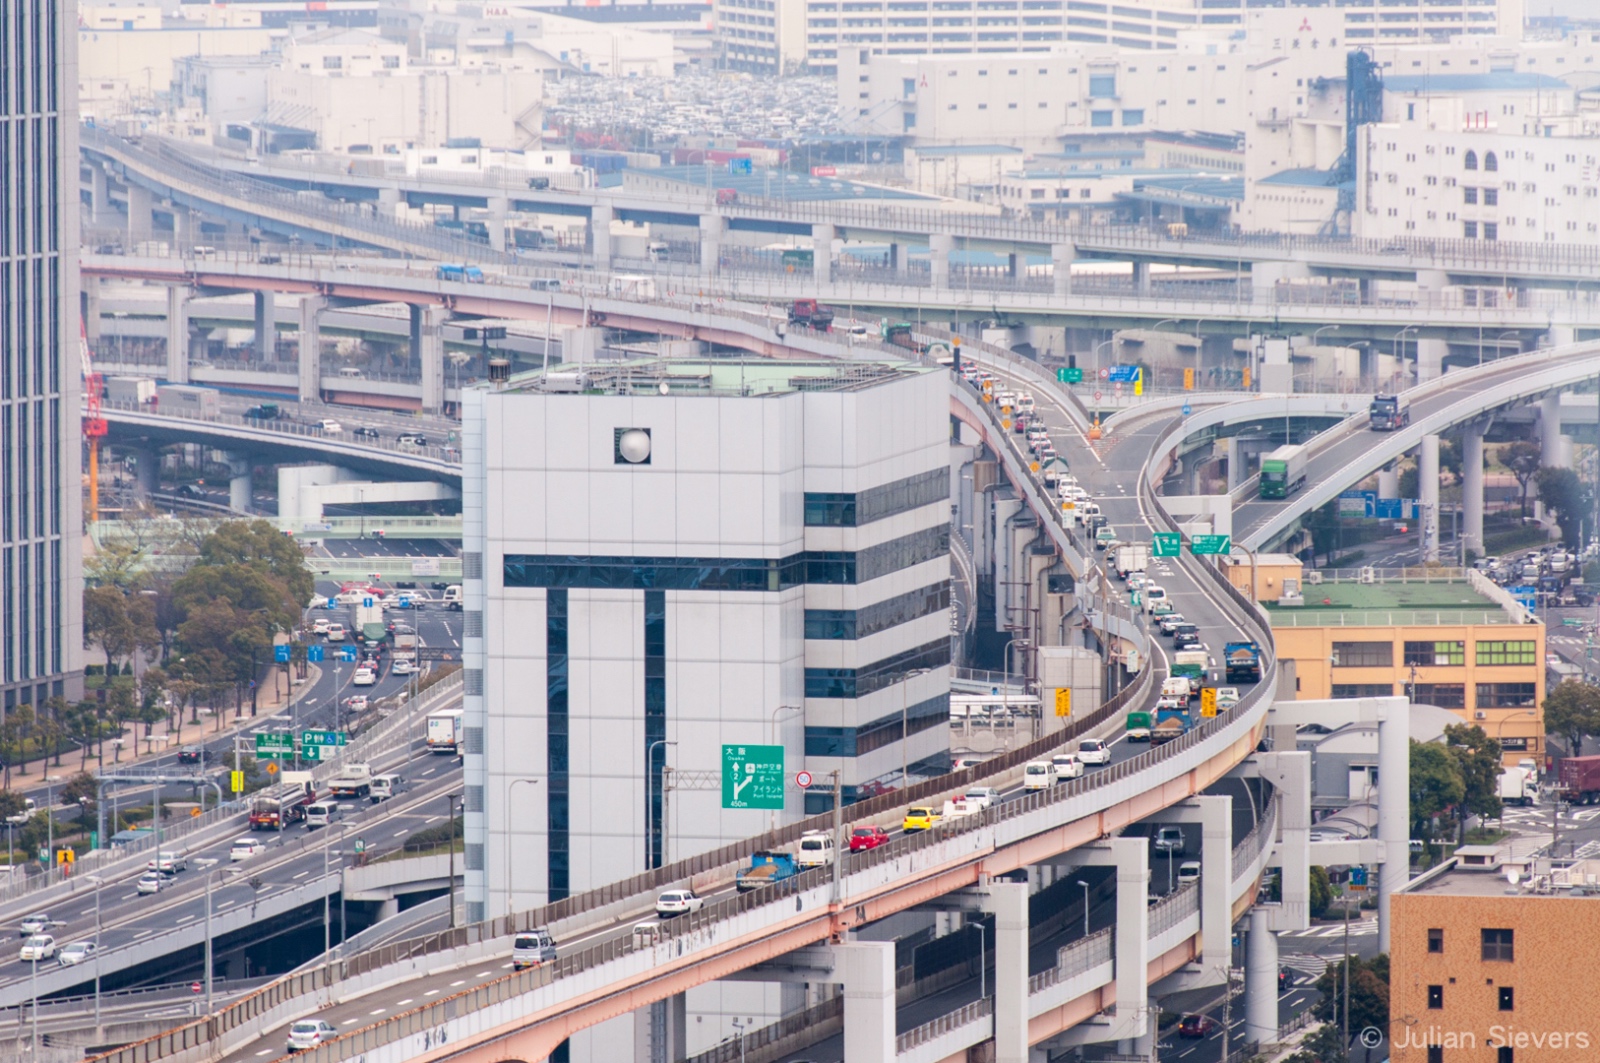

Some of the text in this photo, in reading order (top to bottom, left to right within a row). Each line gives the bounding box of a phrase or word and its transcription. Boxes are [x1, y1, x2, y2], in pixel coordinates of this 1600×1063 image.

[486, 7, 508, 16] HAA
[304, 733, 312, 743] P
[726, 747, 746, 755] 大阪
[759, 775, 776, 783] ポート
[800, 775, 807, 783] 50
[753, 785, 782, 793] アイランド
